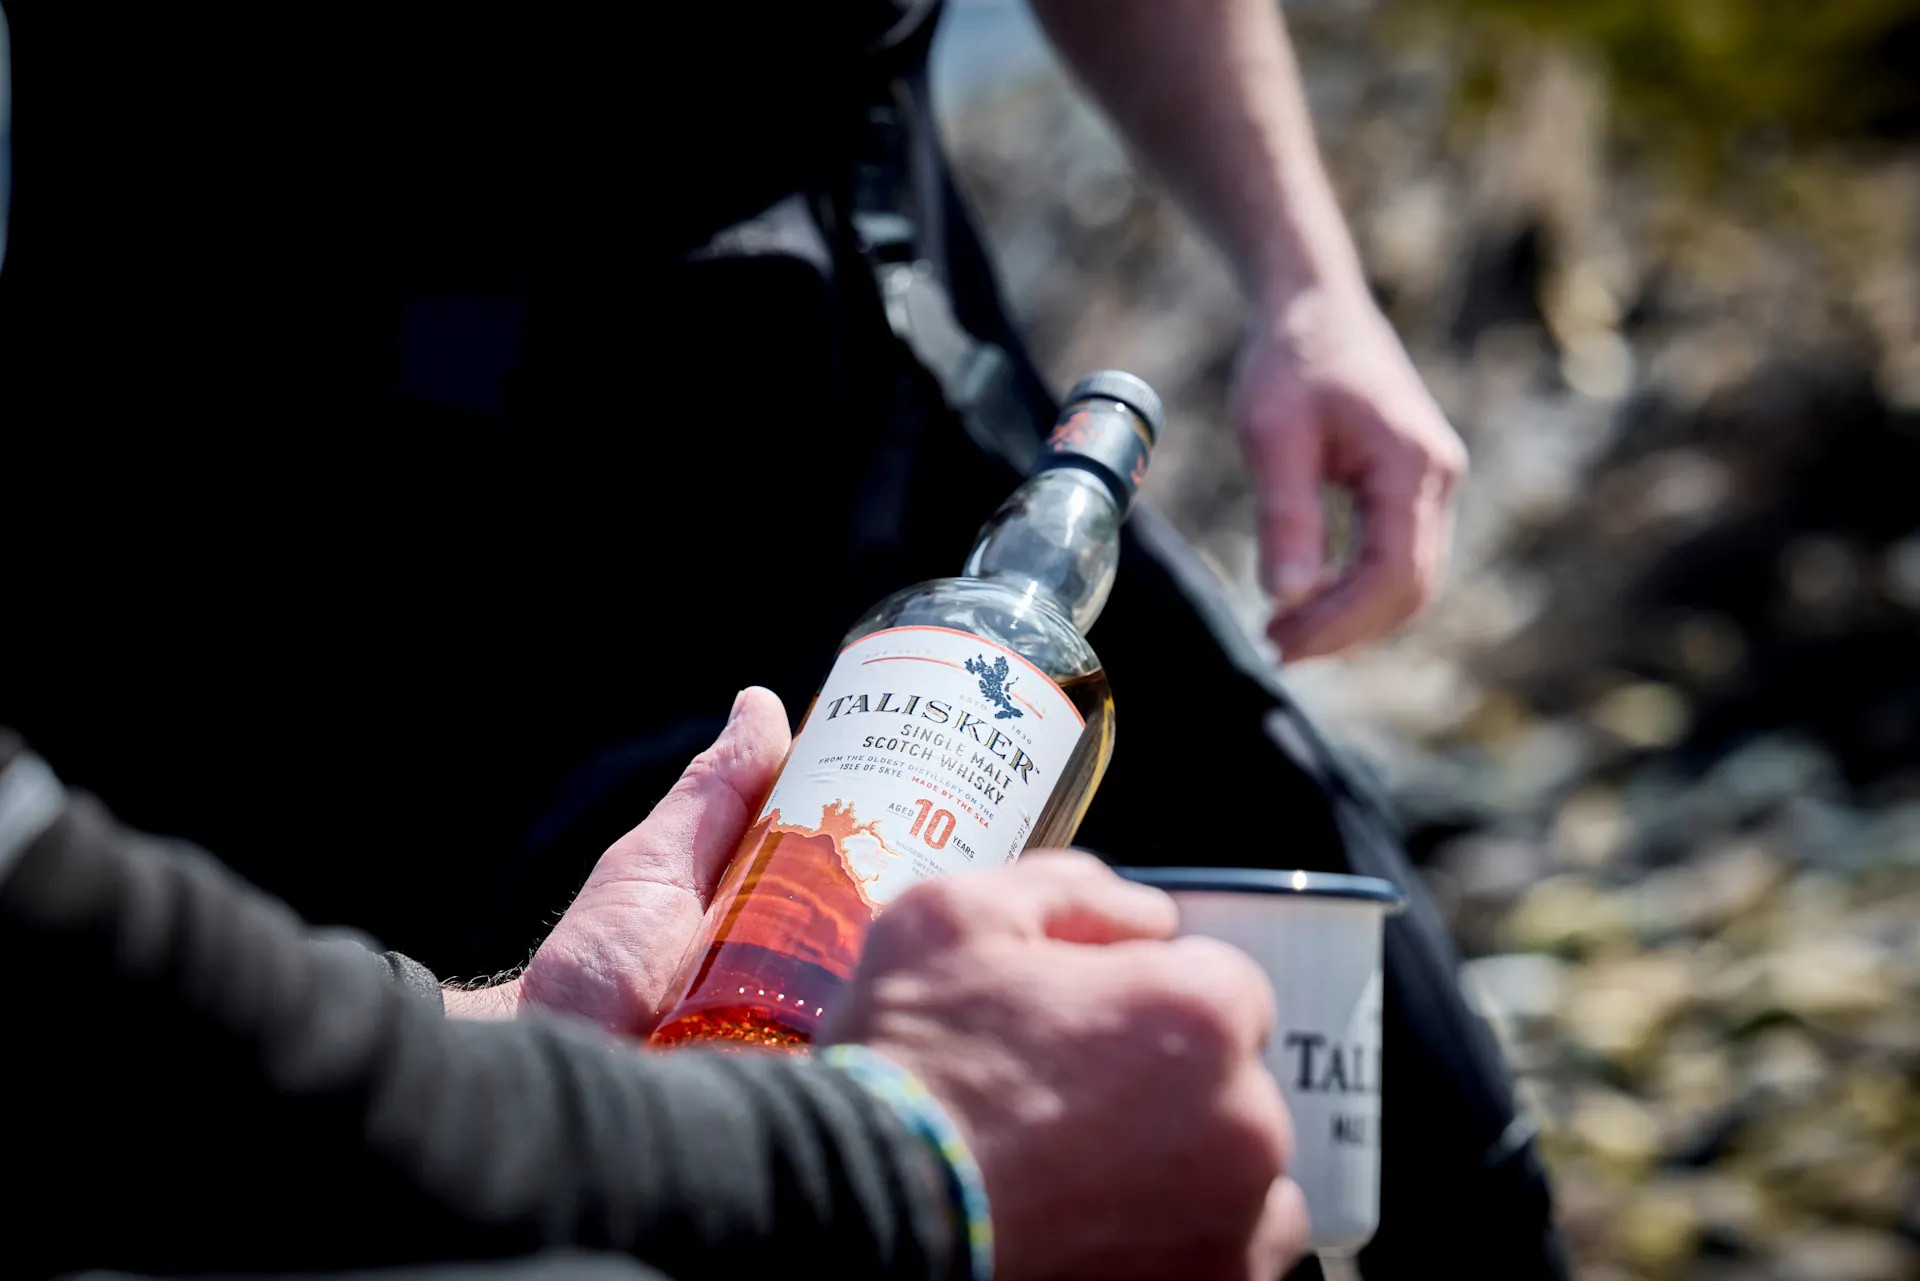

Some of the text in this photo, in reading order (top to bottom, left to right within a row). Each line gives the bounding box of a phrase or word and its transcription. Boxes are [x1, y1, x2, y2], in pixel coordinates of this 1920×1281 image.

[825, 692, 1034, 786] TALISKER
[900, 723, 1012, 790] SINGLE MALT
[1011, 724, 1032, 745] 1830
[818, 755, 843, 765] FROM
[867, 755, 905, 768] OLDEST
[907, 764, 963, 793] DISTILLERY
[965, 793, 978, 804] ON
[979, 803, 995, 820] THE
[839, 763, 990, 829] ISLE OF SKYE MADE BY THE SEA
[862, 735, 1005, 806] SCOTCH WHISKY
[888, 798, 976, 859] AGED 10 YEARS
[1284, 1031, 1381, 1093] TAL
